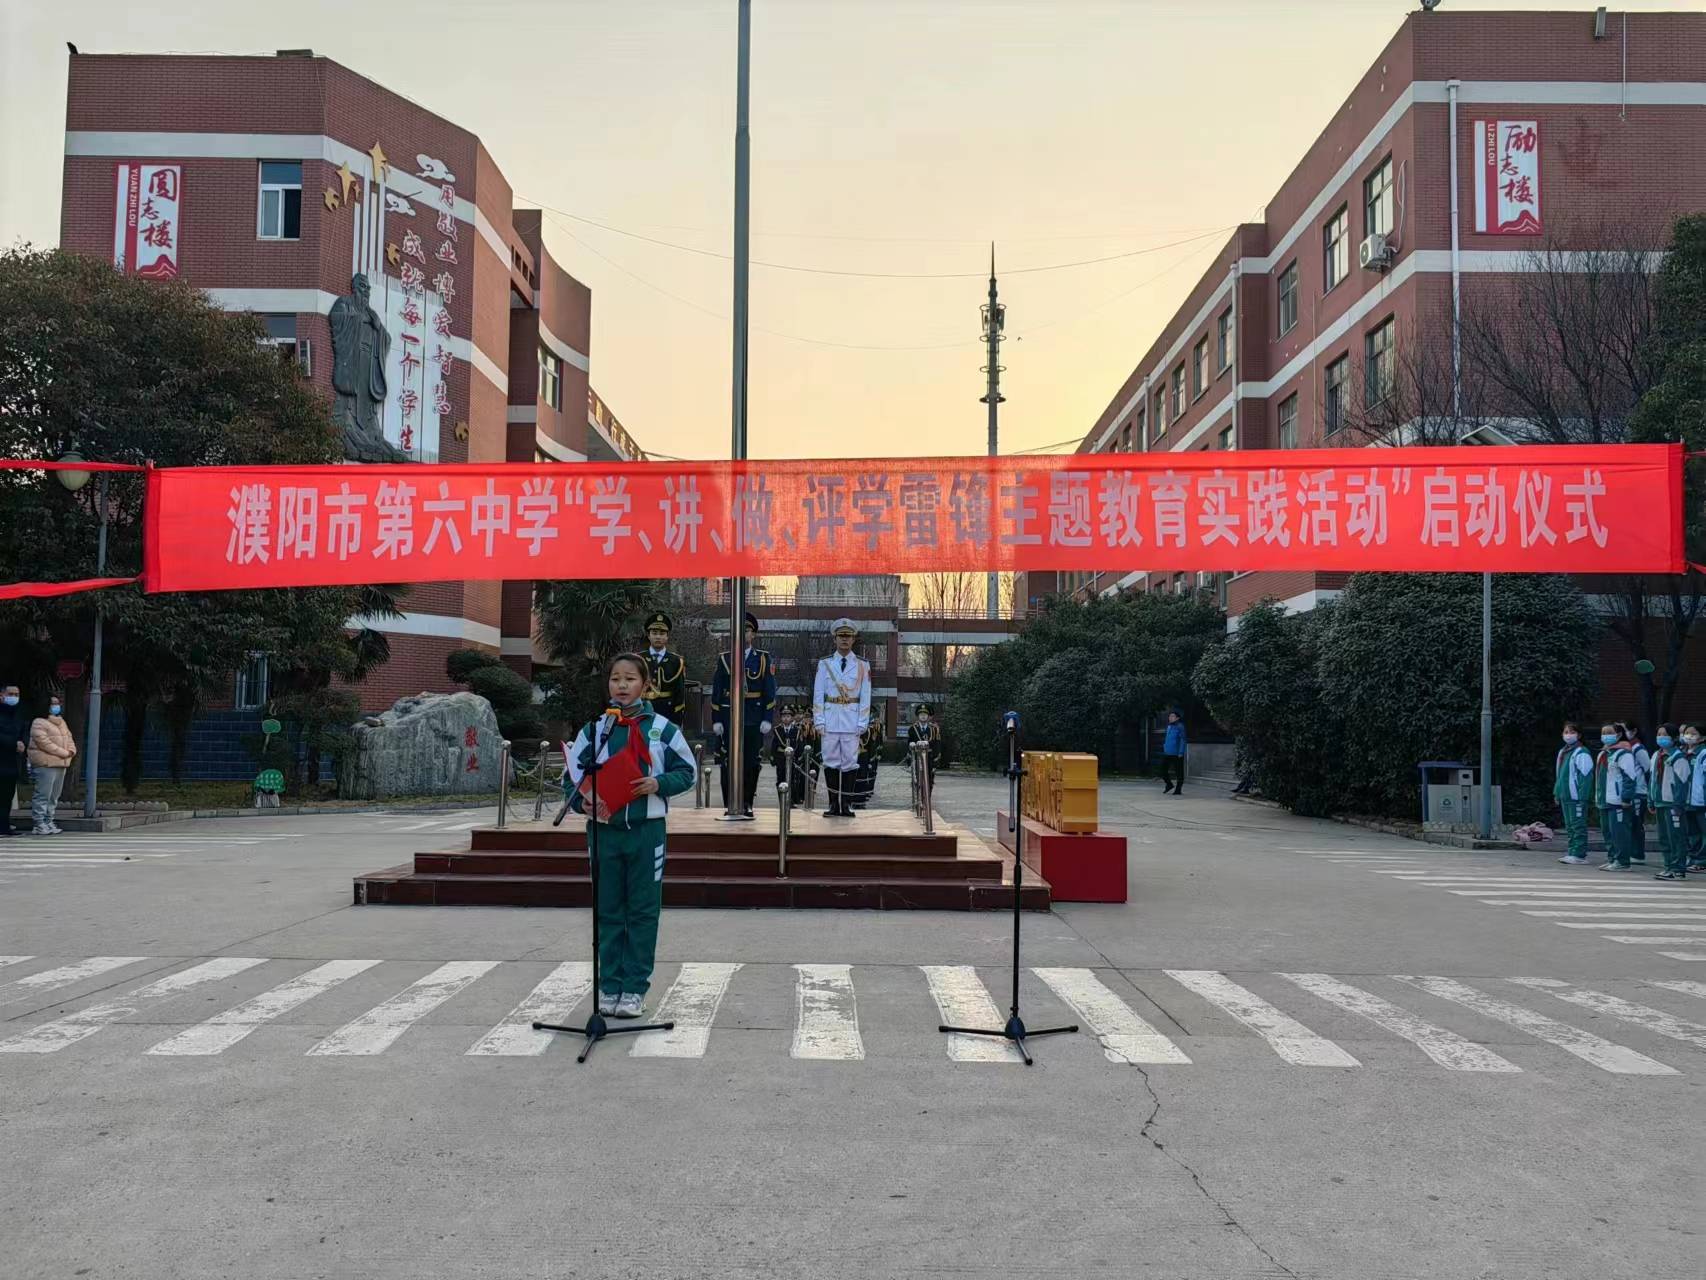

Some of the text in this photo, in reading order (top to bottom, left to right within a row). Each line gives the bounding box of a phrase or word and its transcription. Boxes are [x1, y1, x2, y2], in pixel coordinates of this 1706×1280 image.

[1499, 124, 1537, 206] 励志楼
[140, 168, 177, 249] 圆志楼
[398, 228, 426, 452] 成就每一个学生
[431, 184, 458, 416] 用敬业博爱智慧
[464, 725, 480, 773] 敬业
